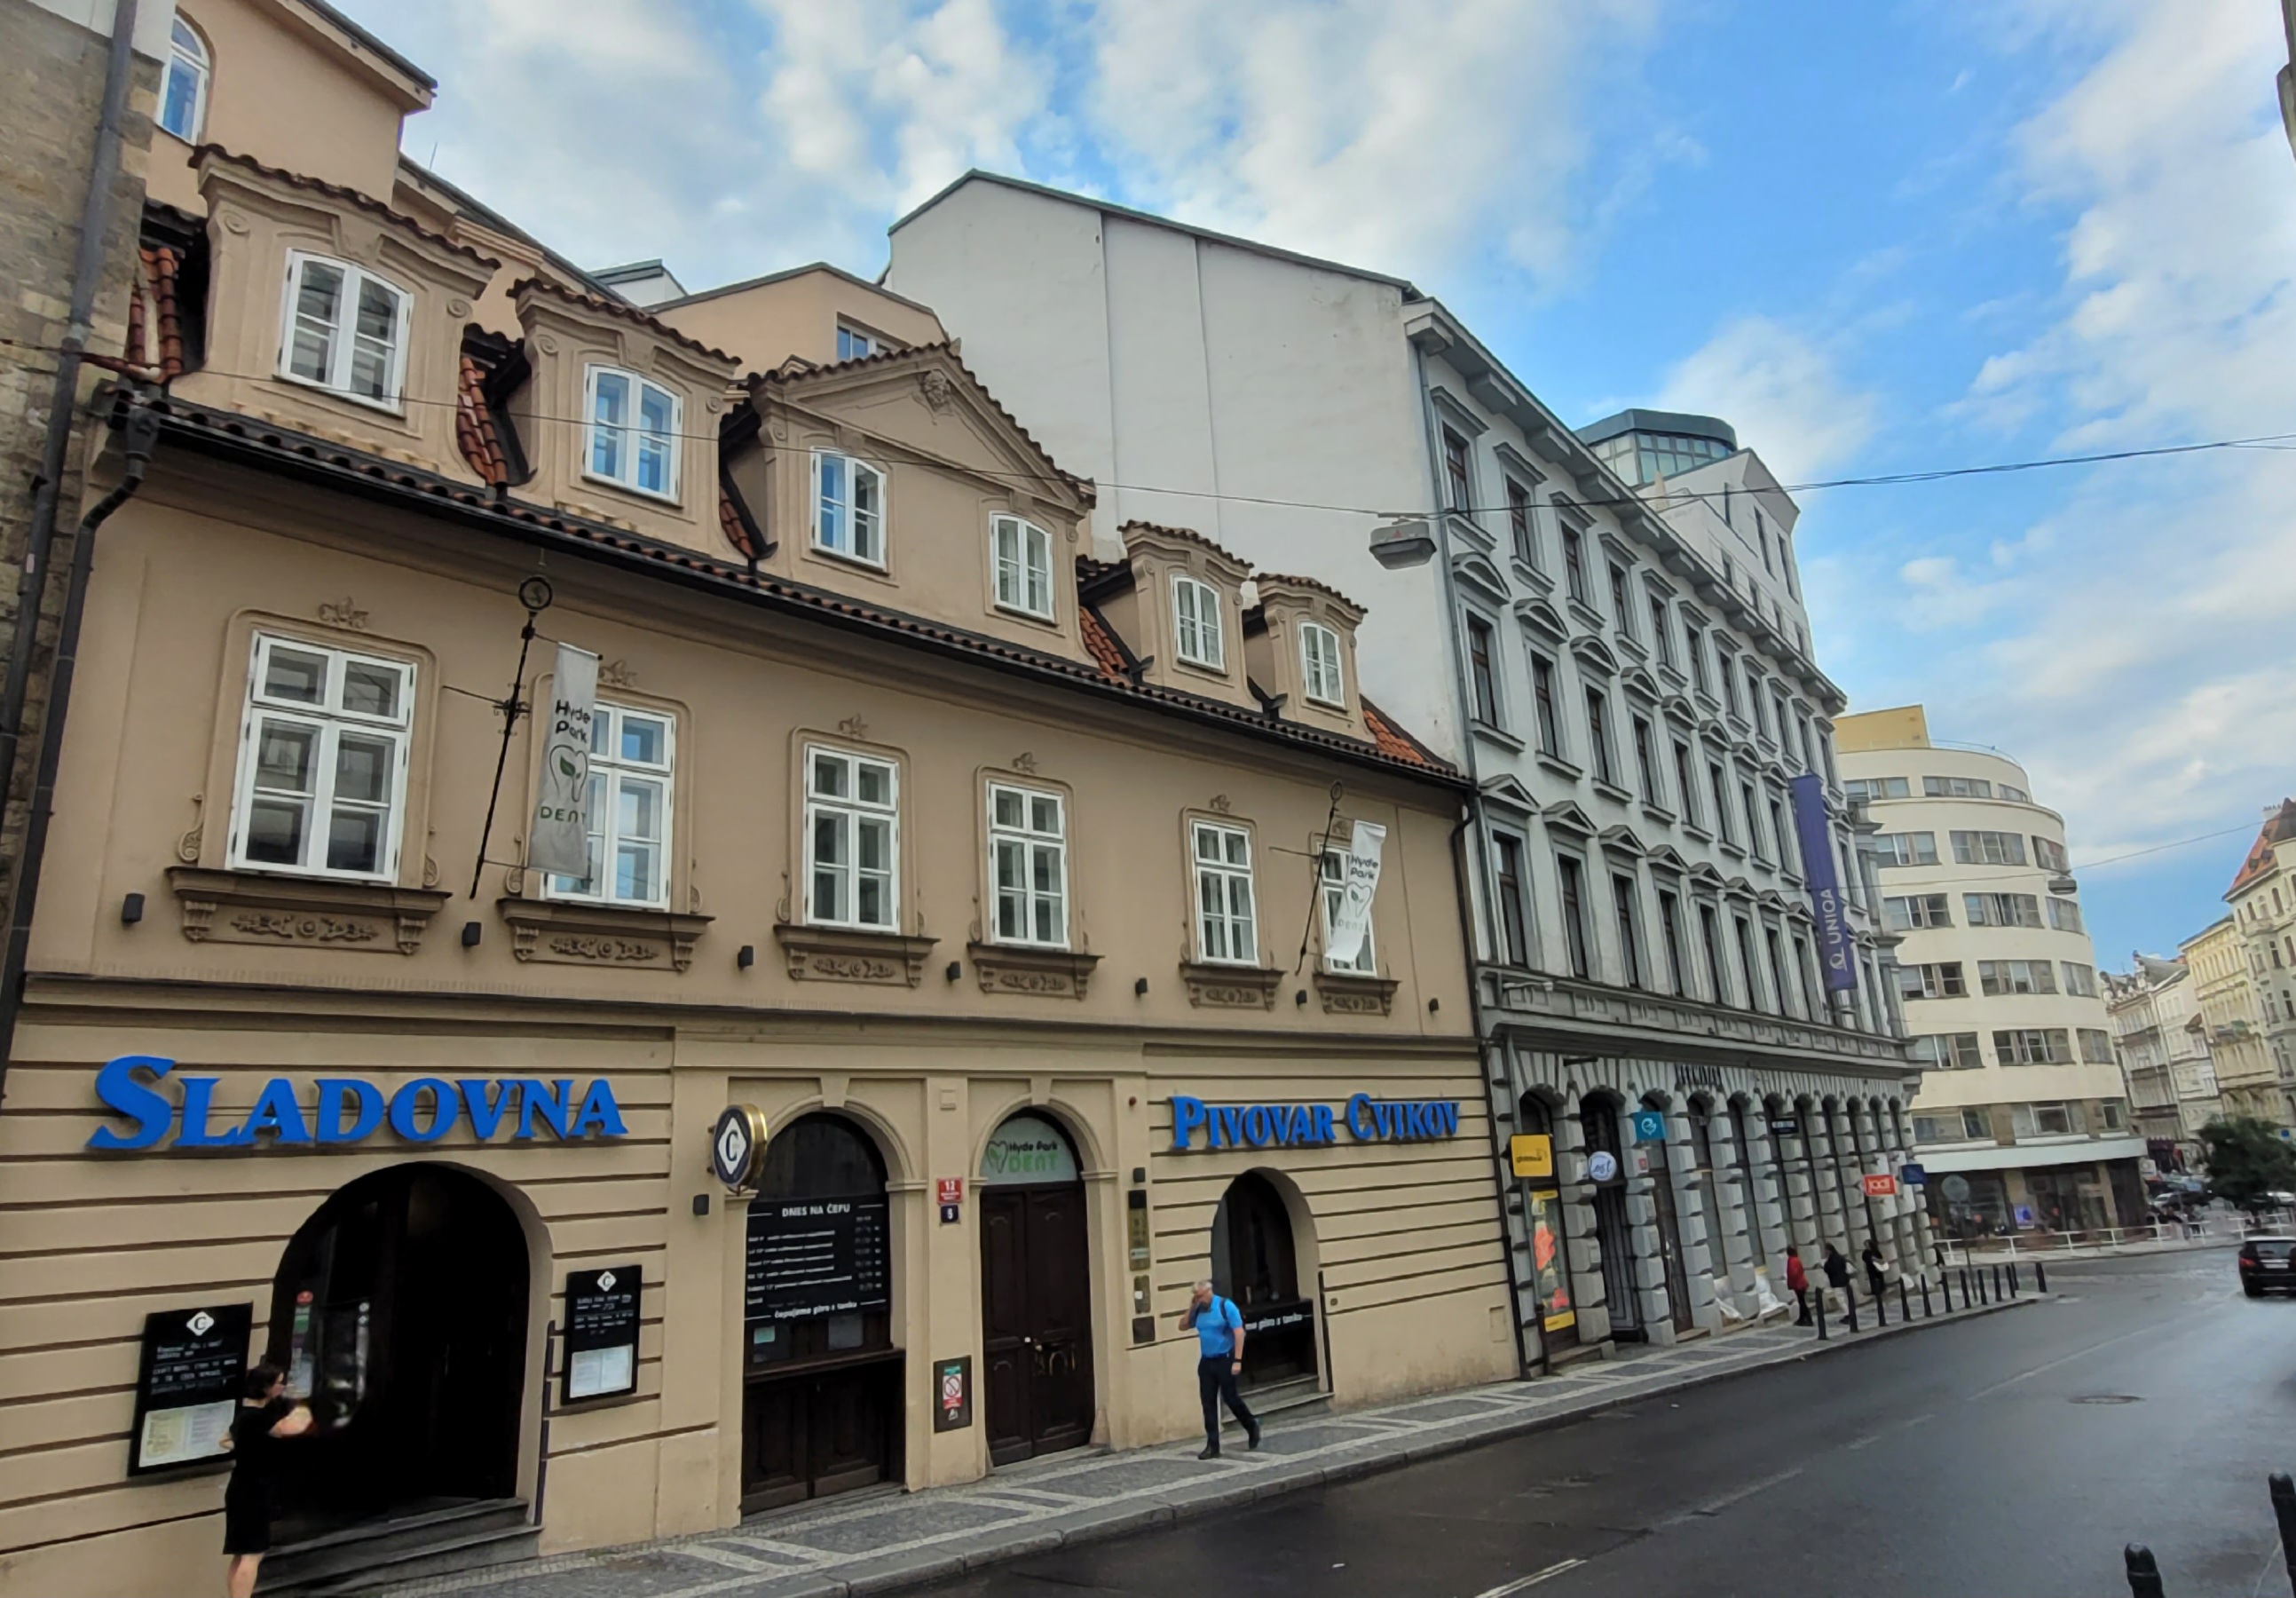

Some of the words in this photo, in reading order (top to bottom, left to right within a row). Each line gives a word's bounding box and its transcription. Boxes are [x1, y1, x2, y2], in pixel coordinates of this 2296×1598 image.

[555, 700, 591, 724] Hyde
[555, 720, 588, 744] Park
[1351, 854, 1378, 868] Hyde
[1350, 866, 1375, 881] Park
[1820, 889, 1842, 945] UNIQA
[84, 1055, 629, 1149] SLADOVNA
[1168, 1095, 1337, 1149] PIVOVAR
[1345, 1092, 1460, 1140] CVIKOV
[1009, 1141, 1034, 1155] Hyde
[1036, 1140, 1058, 1151] Park
[782, 1206, 807, 1217] DNES
[809, 1205, 824, 1215] NA
